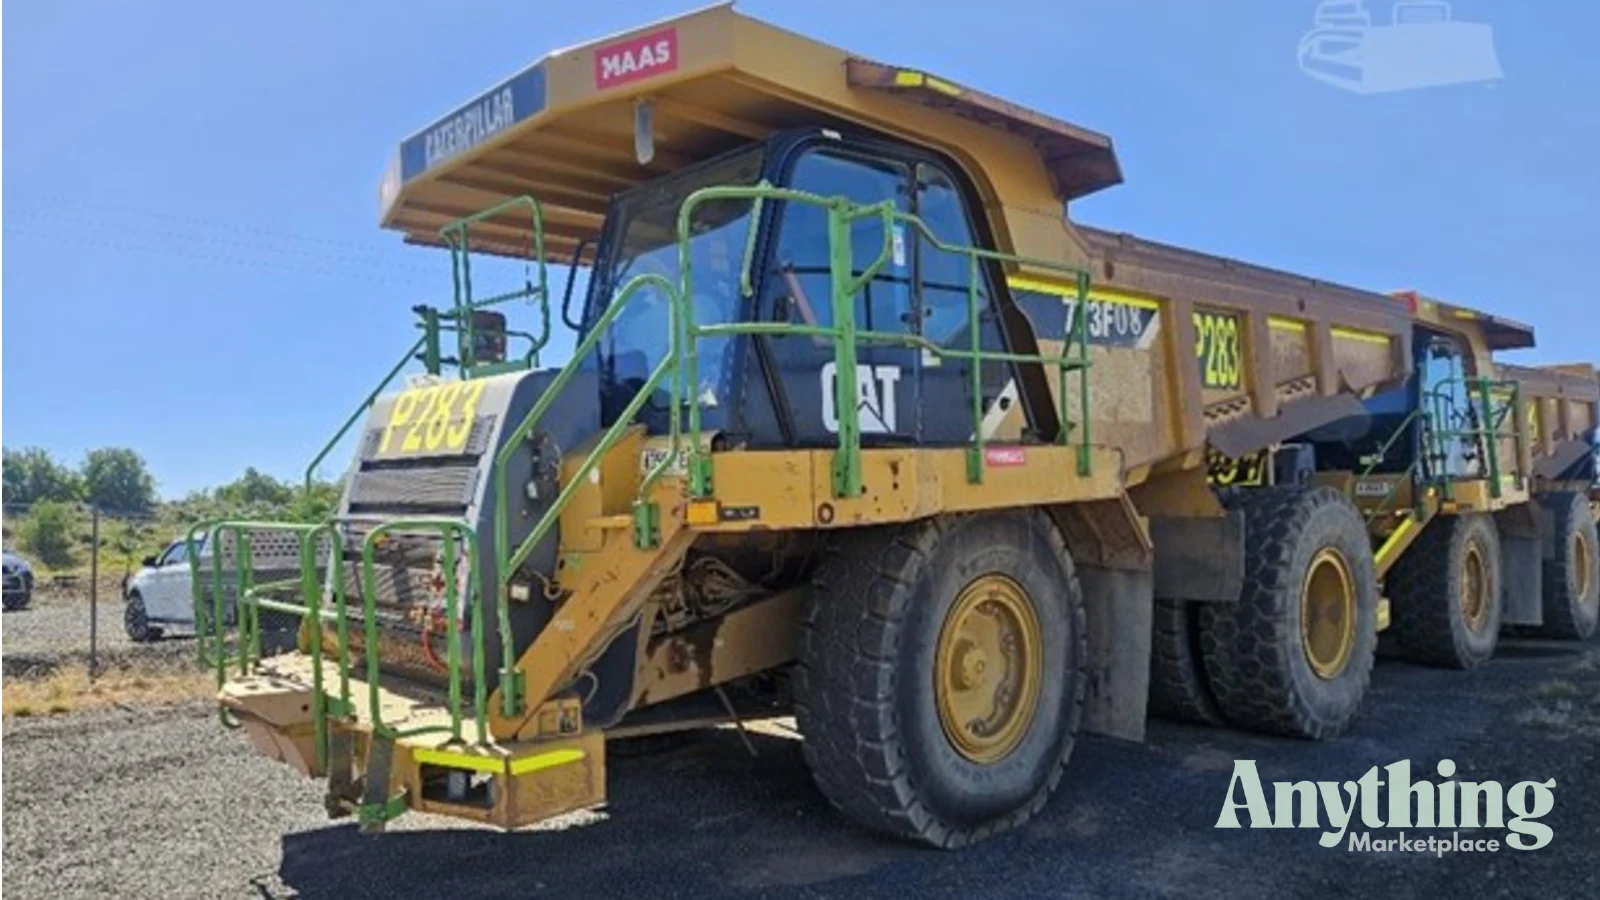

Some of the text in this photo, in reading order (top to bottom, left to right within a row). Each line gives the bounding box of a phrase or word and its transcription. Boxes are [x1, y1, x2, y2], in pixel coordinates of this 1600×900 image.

[601, 41, 670, 79] MAAS
[425, 86, 514, 168] CATERPILLAR
[1062, 295, 1142, 338] 73F08
[379, 379, 487, 453] P283
[820, 361, 900, 434] CAT
